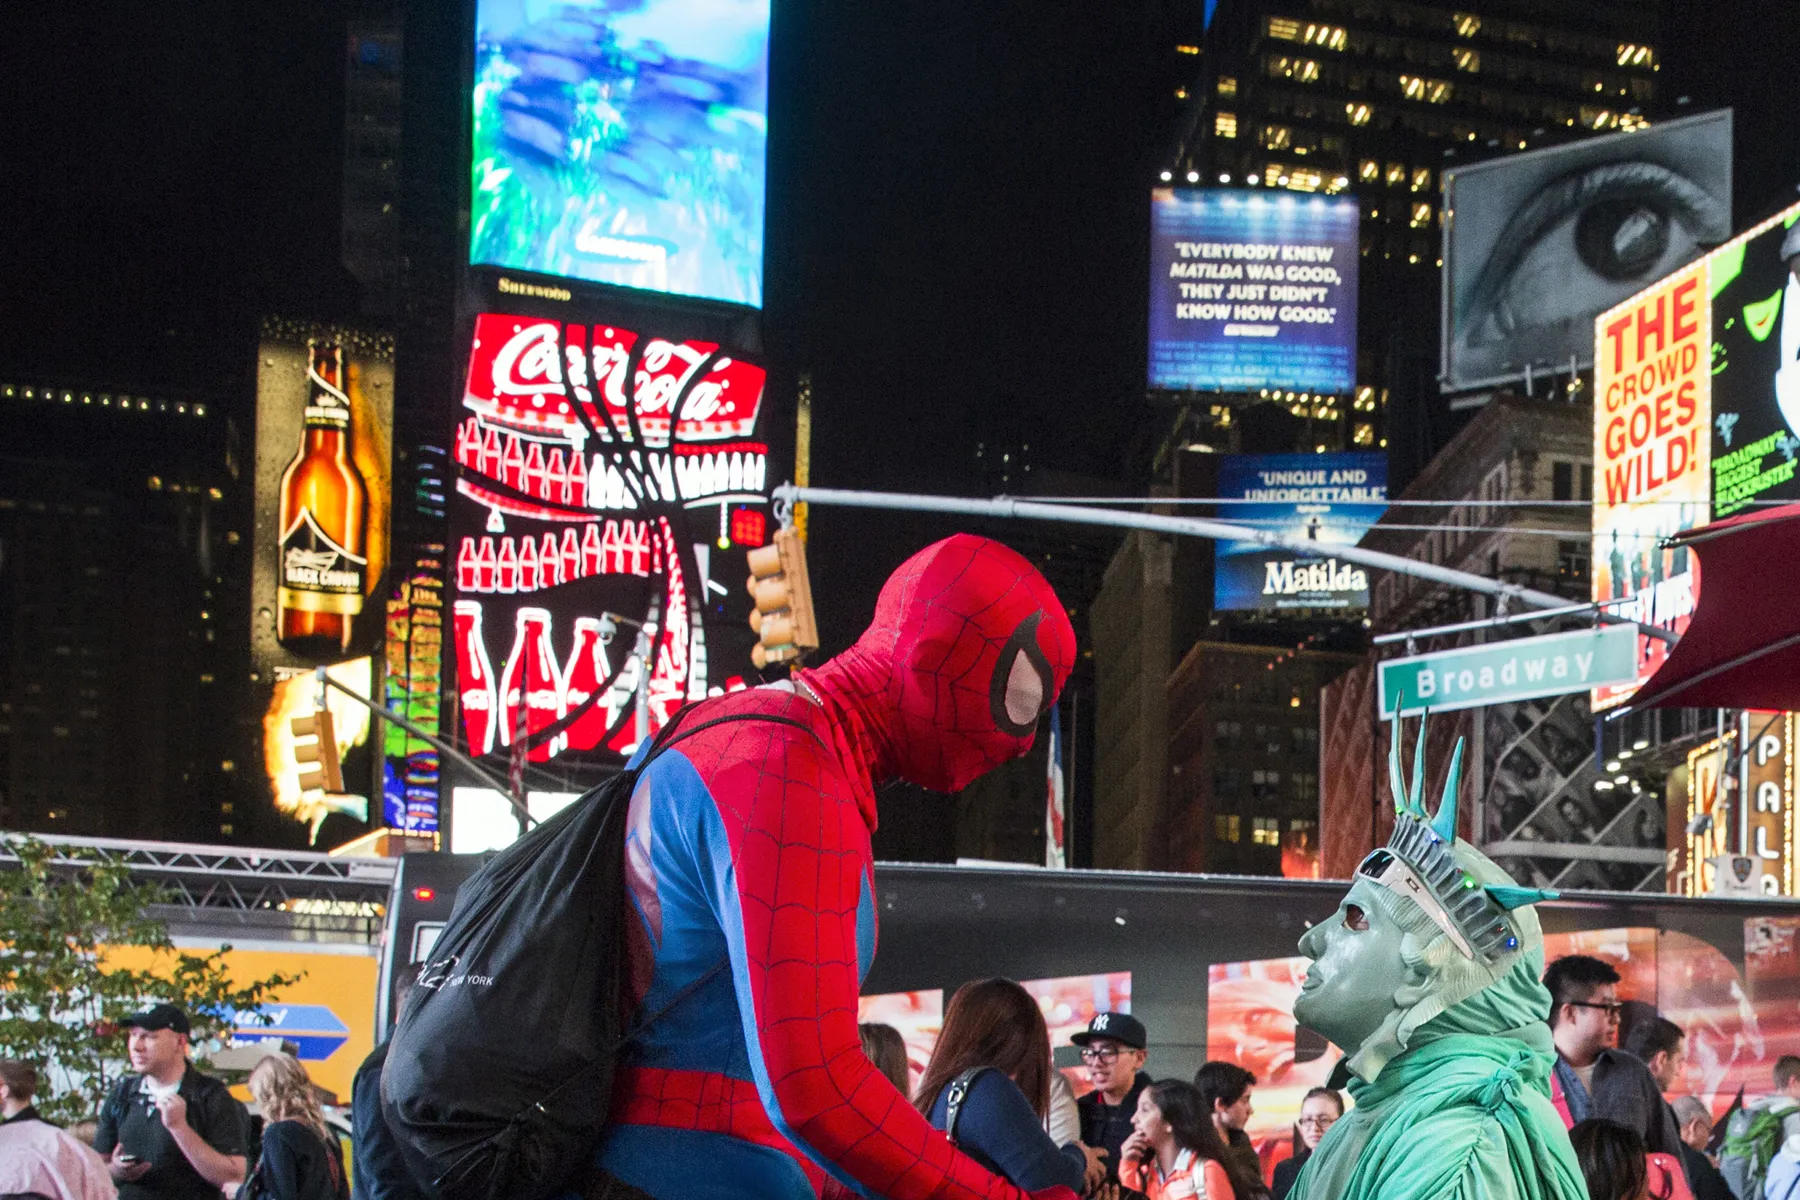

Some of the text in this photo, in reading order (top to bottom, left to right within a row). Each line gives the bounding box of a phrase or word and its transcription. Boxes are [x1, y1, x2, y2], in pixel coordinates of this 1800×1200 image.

[1174, 241, 1334, 262] "EVERYBODY KNEW
[1169, 262, 1342, 286] MATILDA WAS GOOD,
[1178, 282, 1329, 303] THEY JUST DIDN'T
[1176, 303, 1232, 320] KNOW
[1233, 304, 1277, 321] HOW
[1606, 276, 1697, 375] THE
[1606, 342, 1697, 413] CROWD
[1605, 380, 1697, 461] GOES
[1258, 469, 1367, 486] "UNIQUE AND
[1605, 429, 1697, 508] WILD!
[1262, 558, 1368, 594] Matilda
[1416, 651, 1595, 698] Broadway
[467, 974, 494, 986] YORK
